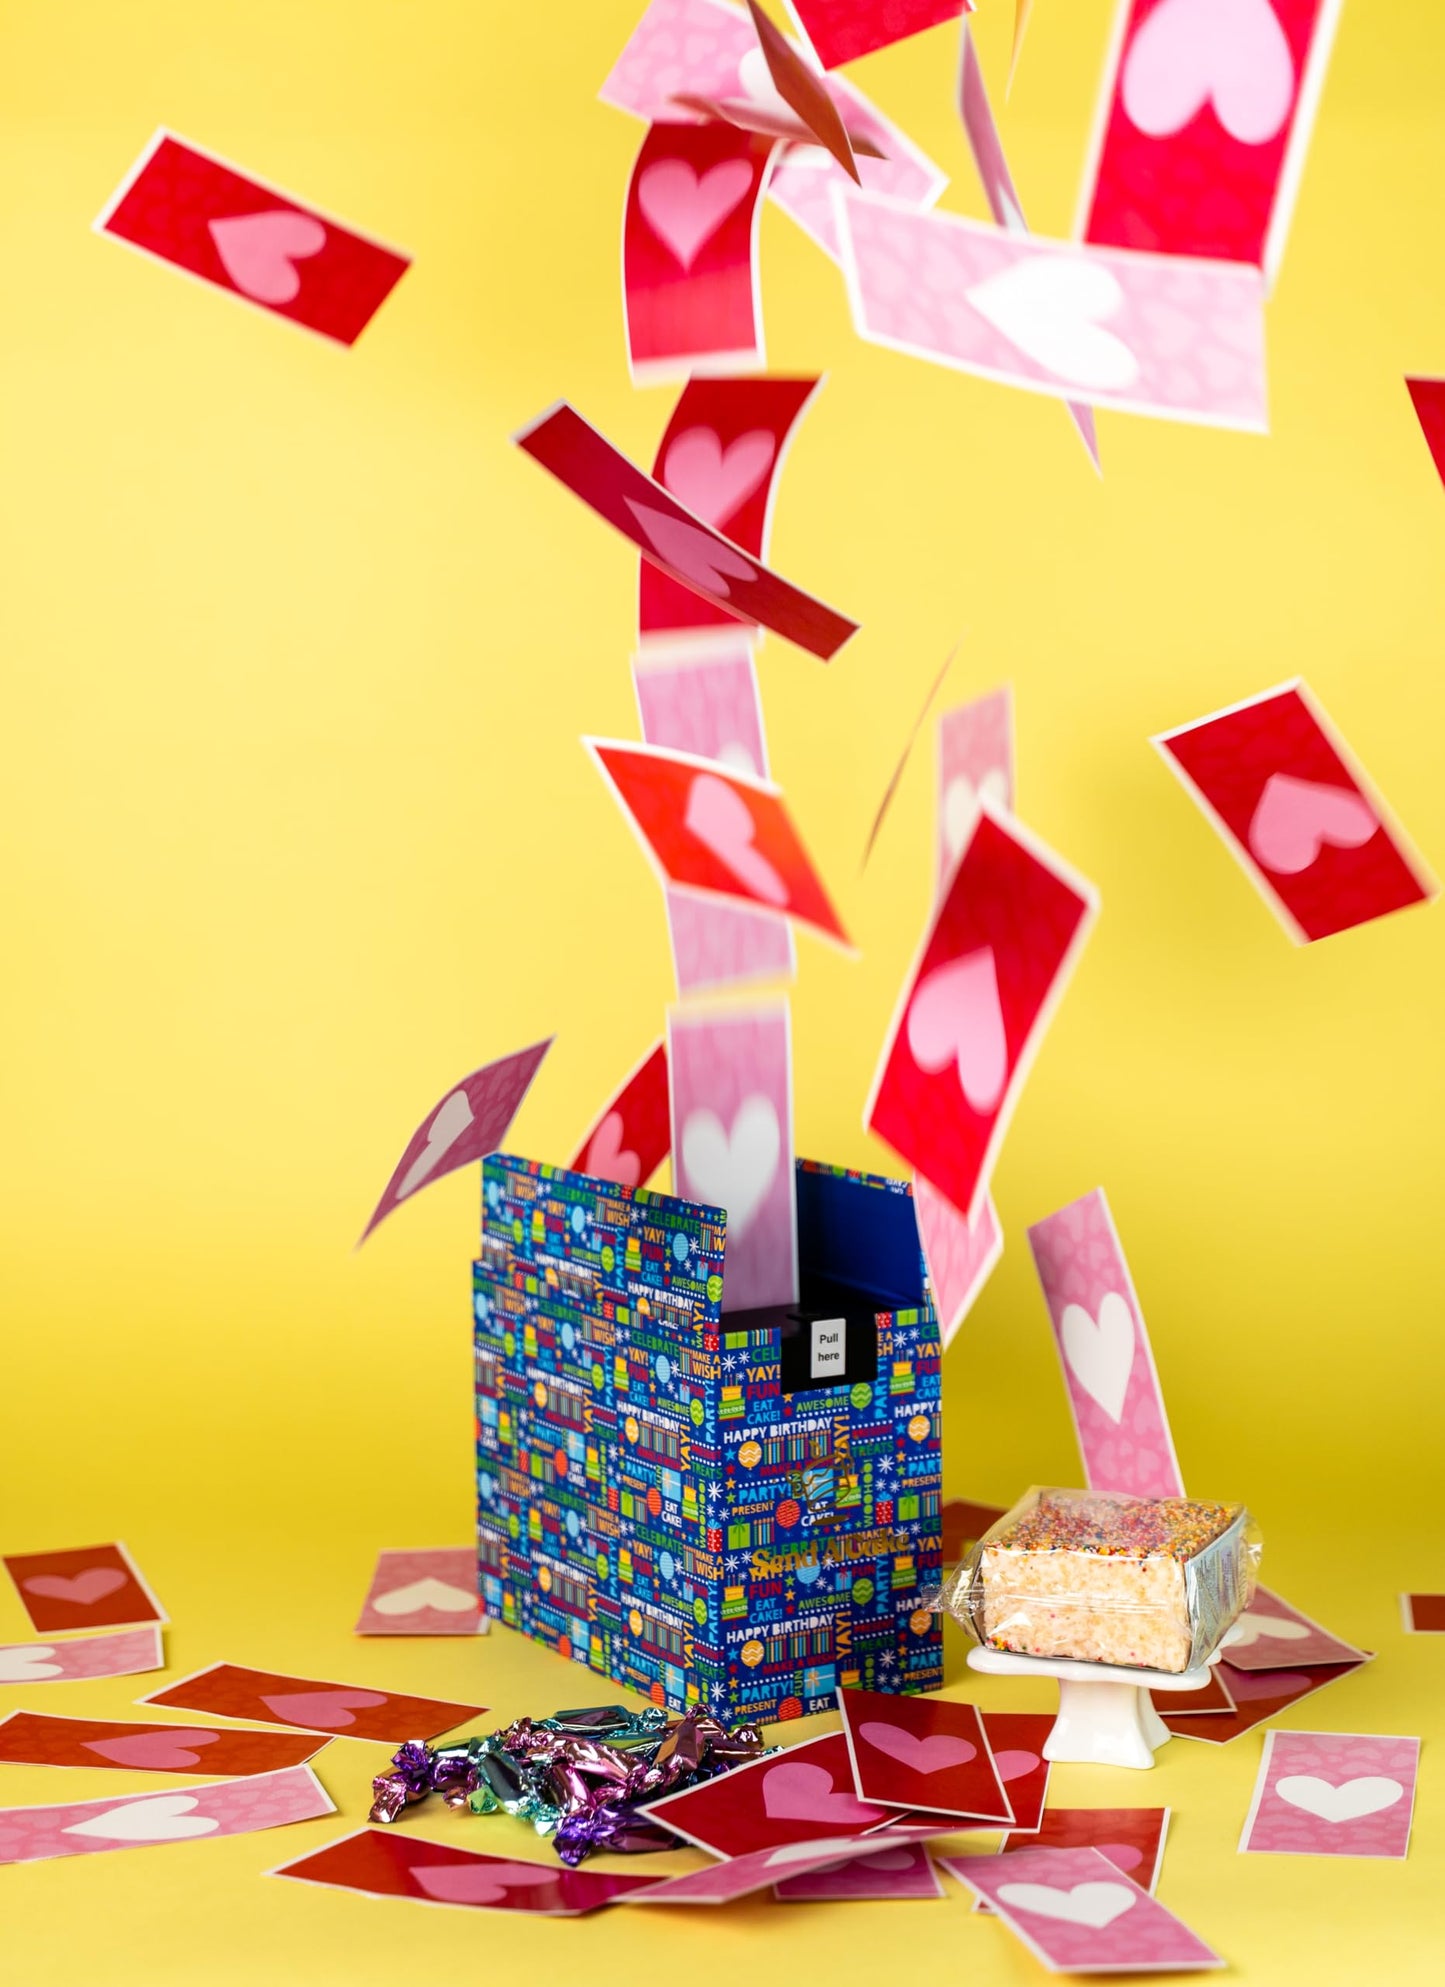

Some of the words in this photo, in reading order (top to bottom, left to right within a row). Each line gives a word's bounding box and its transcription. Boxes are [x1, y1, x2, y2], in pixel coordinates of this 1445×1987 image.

[606, 1209, 630, 1228] WISH
[647, 1209, 701, 1235] CELEBRATE
[643, 1225, 665, 1246] YAY!
[641, 1242, 664, 1262] FUN
[645, 1259, 660, 1274] EAT
[641, 1270, 663, 1287] CAKE!
[671, 1275, 706, 1295] AWESOME
[627, 1281, 655, 1301] HAPPY
[653, 1288, 694, 1312] BIRTHDAY
[592, 1328, 616, 1348] WISH
[630, 1328, 681, 1358] CELEBRATE
[819, 1333, 839, 1345] Pull
[628, 1346, 650, 1367] YAY!
[691, 1350, 712, 1367] MAKE
[713, 1354, 721, 1365] A
[817, 1350, 840, 1363] here
[628, 1362, 650, 1384] FUN
[691, 1360, 722, 1381] WISH
[745, 1364, 781, 1383] YAY!
[632, 1379, 647, 1394] EAT
[746, 1383, 780, 1400] FUN
[629, 1390, 650, 1408] CAKE!
[656, 1395, 691, 1418] AWESOME
[753, 1399, 775, 1412] EAT
[796, 1397, 850, 1413] AWESOME
[616, 1399, 643, 1421] HAPPY
[641, 1409, 680, 1434] BIRTHDAY
[704, 1380, 716, 1444] PARTY!
[747, 1411, 781, 1425] CAKE!
[895, 1400, 936, 1419] HAPPY
[723, 1427, 767, 1444] HAPPY
[769, 1417, 833, 1437] BIRTHDAY
[679, 1423, 692, 1473] YAY!
[851, 1441, 894, 1457] TREATS
[625, 1460, 658, 1488] PARTY!
[690, 1460, 723, 1480] TREATS
[621, 1474, 648, 1492] PRESENT
[738, 1484, 792, 1504] PARTY!
[862, 1459, 873, 1528] WOOHOO!
[664, 1500, 679, 1515] EAT
[698, 1477, 707, 1549] WOOHOO!
[731, 1501, 775, 1516] PRESENT
[596, 1518, 620, 1540] WISH
[660, 1510, 683, 1528] CAKE!
[632, 1539, 653, 1562] YAY!
[635, 1524, 684, 1557] CELEBRATE
[750, 1540, 818, 1574] Send
[822, 1536, 844, 1565] A
[845, 1527, 910, 1561] Cake
[632, 1556, 654, 1578] FUN
[695, 1548, 714, 1566] MAKE
[716, 1555, 725, 1567] A
[636, 1573, 650, 1588] EAT
[695, 1559, 725, 1582] WISH
[851, 1564, 876, 1578] FUN
[633, 1584, 654, 1602] CAKE!
[749, 1582, 782, 1600] FUN
[798, 1592, 851, 1609] AWESOME
[620, 1591, 647, 1614] HAPPY
[645, 1602, 684, 1631] BIRTHDAY
[660, 1591, 694, 1615] AWESOME
[708, 1580, 719, 1644] PARTY!
[755, 1598, 777, 1611] EAT
[749, 1608, 783, 1625] CAKE!
[726, 1625, 770, 1644] HAPPY
[772, 1613, 835, 1636] BIRTHDAY
[835, 1610, 852, 1660] YAY!
[683, 1620, 694, 1669] YAY!
[629, 1652, 661, 1681] PARTY!
[694, 1659, 726, 1680] TREATS
[762, 1660, 794, 1675] MAKE
[797, 1658, 805, 1670] A
[807, 1653, 837, 1669] WISH
[625, 1666, 651, 1686] PRESENT
[793, 1669, 804, 1697] FUN
[741, 1680, 794, 1703] PARTY!
[668, 1695, 681, 1712] EAT
[735, 1699, 778, 1716] PRESENT
[809, 1697, 830, 1712] EAT
